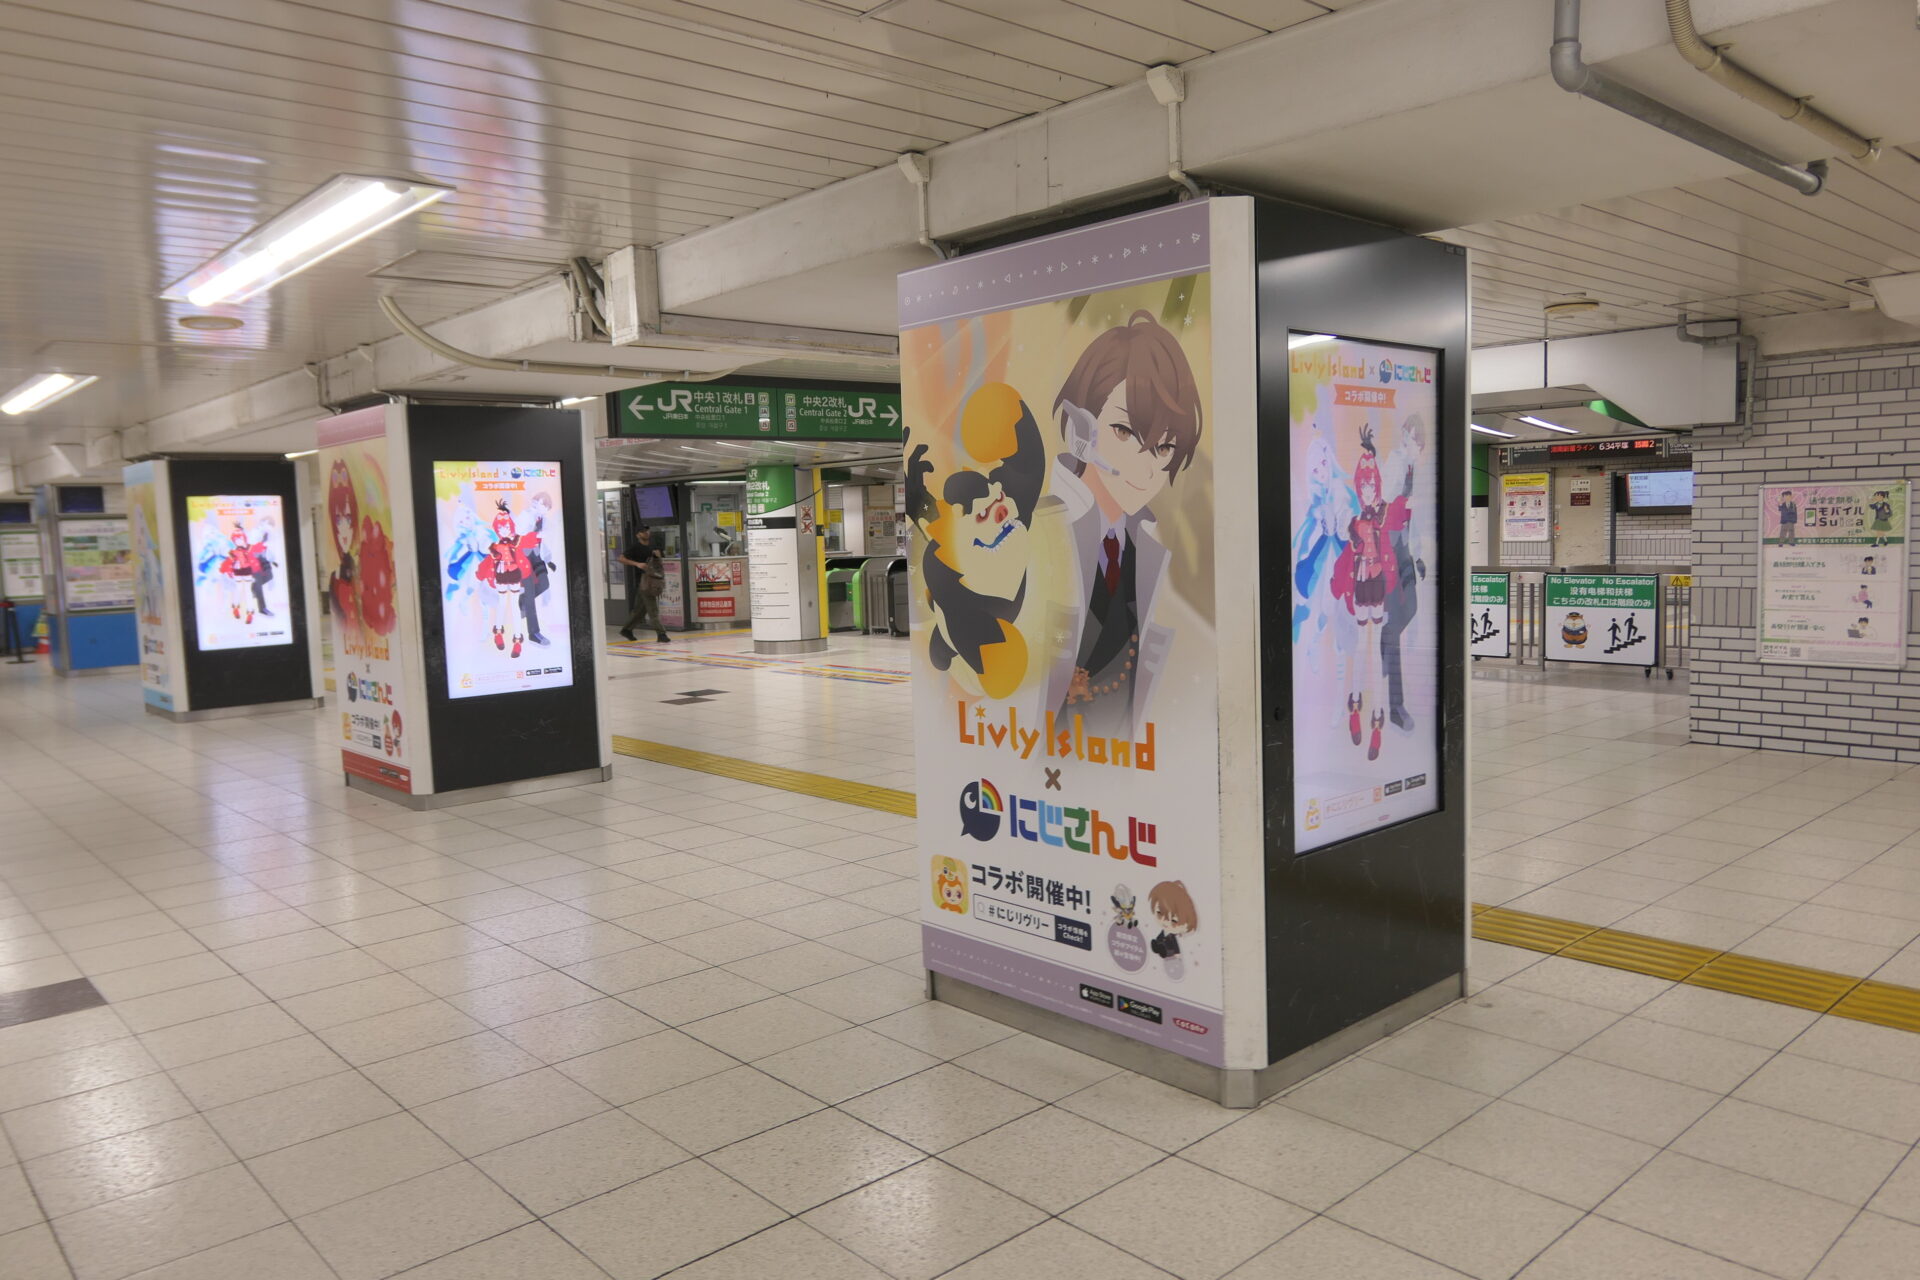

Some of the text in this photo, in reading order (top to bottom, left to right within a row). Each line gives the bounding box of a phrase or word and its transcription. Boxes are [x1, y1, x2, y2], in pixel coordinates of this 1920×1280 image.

[1291, 351, 1326, 380] Livly
[1327, 354, 1365, 380] Island
[657, 389, 693, 412] JR
[694, 391, 742, 405] 中央1改札
[803, 396, 847, 408] 中央2改札
[694, 403, 748, 414] Central Gate 1
[799, 408, 848, 417] Central Gate 2
[847, 397, 877, 418] JR
[1819, 506, 1864, 516] モバイル
[1819, 517, 1864, 527] Suica
[1472, 575, 1506, 584] Escalator
[1564, 577, 1596, 585] Elevator
[1615, 578, 1654, 586] Escalator
[1570, 587, 1633, 597] 没有电梯和扶梯
[1552, 597, 1651, 607] こちらの改札口は階段のみ
[957, 700, 1155, 771] Livly Island
[1009, 794, 1157, 868] にじさんじ
[971, 863, 1091, 915] コラボ開催中!
[988, 904, 1049, 930] #にじリヴリー
